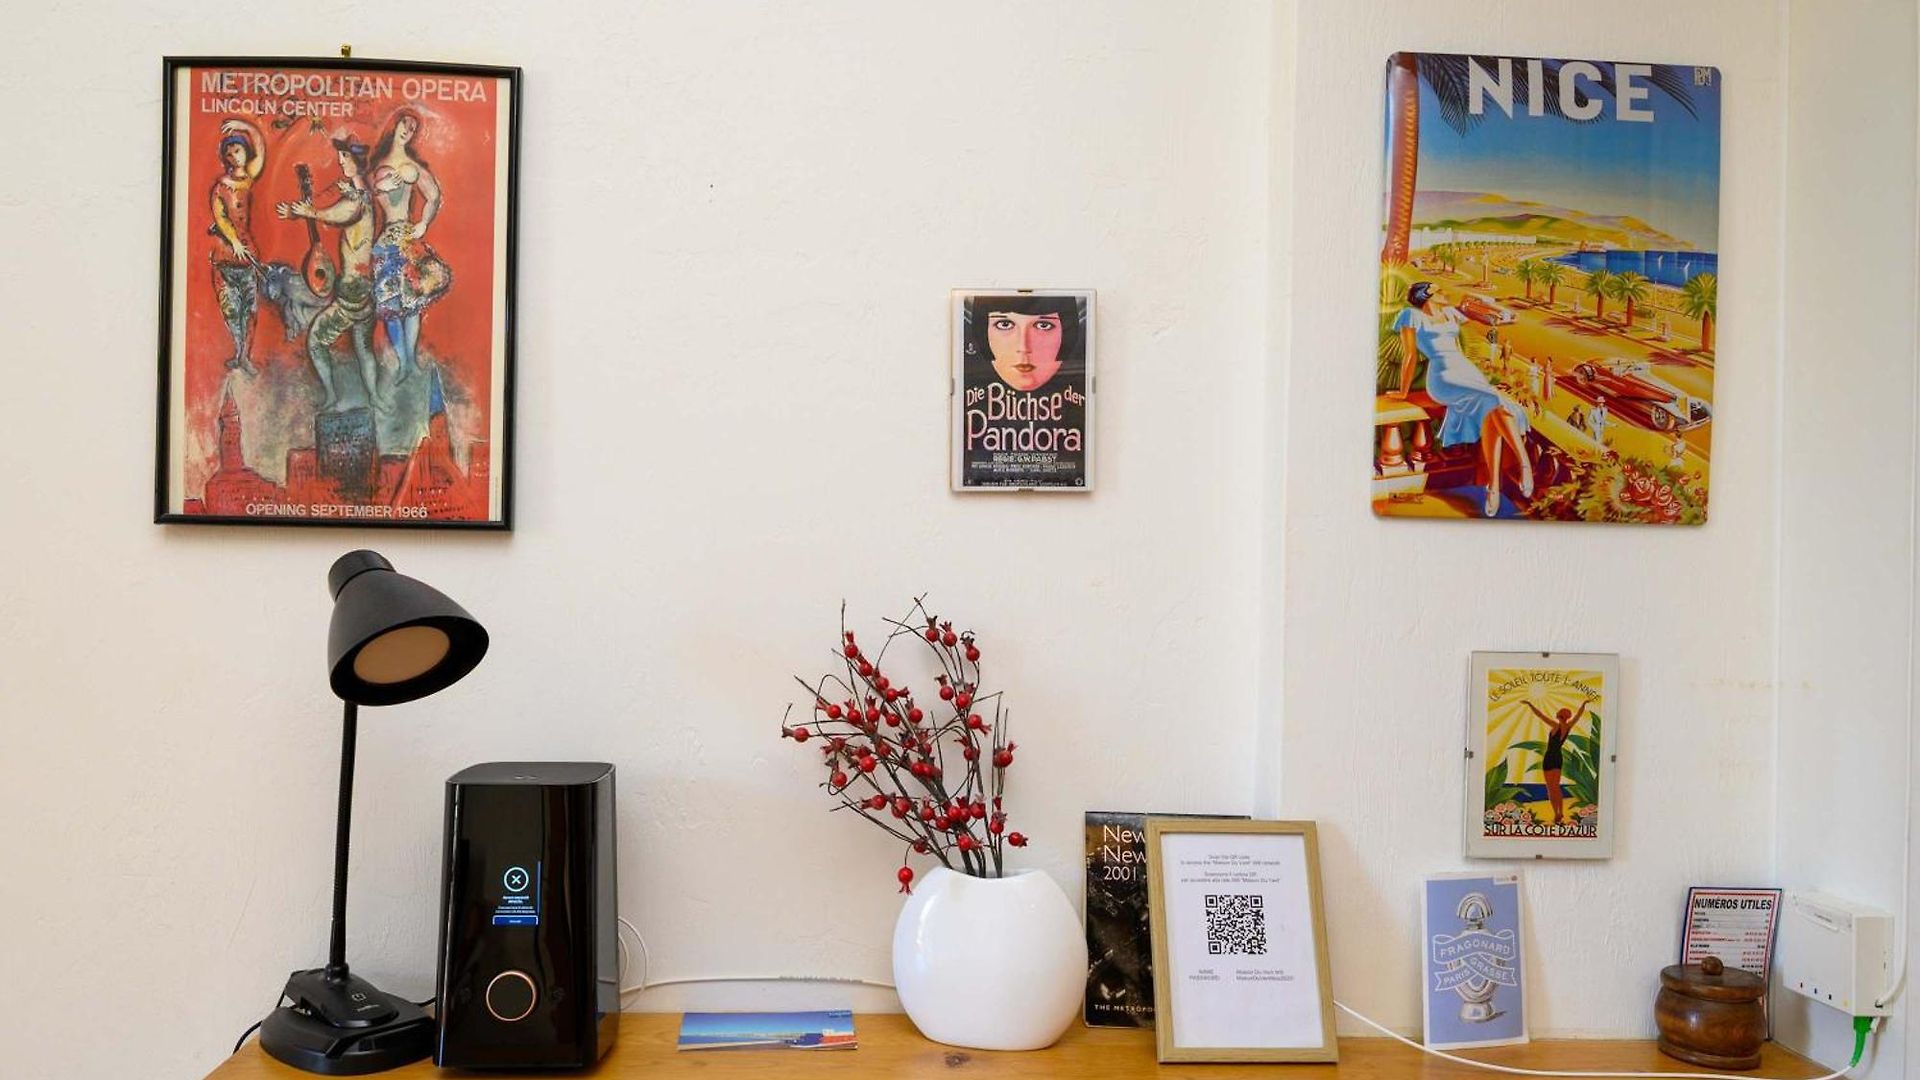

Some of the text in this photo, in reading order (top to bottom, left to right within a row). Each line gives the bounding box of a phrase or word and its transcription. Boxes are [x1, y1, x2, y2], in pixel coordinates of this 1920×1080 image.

[201, 72, 487, 103] METROPOLITAN OPERA
[1467, 56, 1654, 122] NICE
[201, 98, 352, 117] LINCOLN CENTER
[967, 382, 1086, 422] Die Büchse der
[967, 409, 1081, 452] Pandora
[246, 503, 307, 517] OPENING
[310, 504, 392, 518] SEPTEMBER
[396, 506, 428, 519] 1966
[1500, 674, 1527, 694] SOLEIL
[1530, 672, 1561, 683] TOUTE
[1484, 822, 1506, 836] SUR
[1510, 823, 1523, 836] LA
[1559, 824, 1598, 838] D'AZUR
[1103, 866, 1136, 881] 2001
[1694, 897, 1772, 911] NUMÉROS UTILES
[1440, 939, 1511, 958] FRAGONARD
[1443, 967, 1471, 983] PARIS
[1471, 957, 1509, 980] GRASSE
